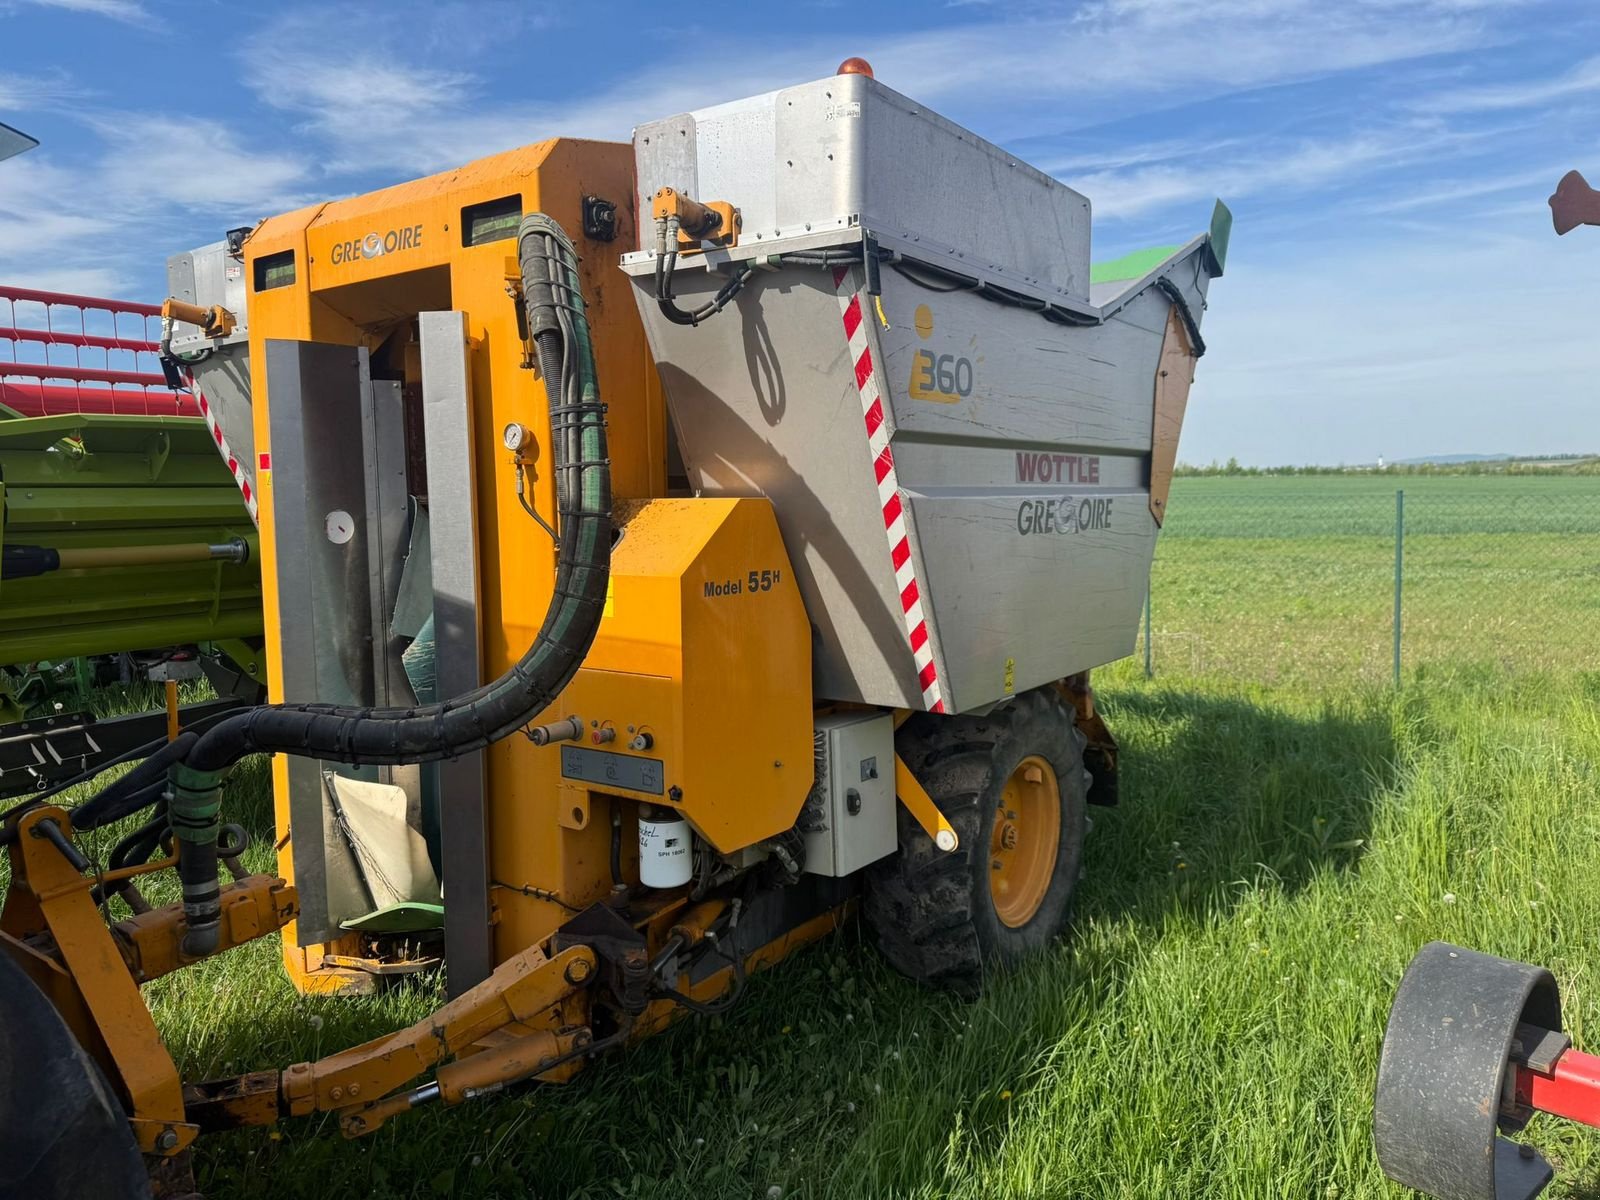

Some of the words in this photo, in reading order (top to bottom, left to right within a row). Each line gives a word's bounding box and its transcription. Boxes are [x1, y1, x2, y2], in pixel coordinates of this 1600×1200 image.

[331, 224, 422, 265] GREGOIRE
[1016, 452, 1099, 483] WOTTLE
[1017, 497, 1113, 536] GREGOIRE
[704, 579, 742, 597] Model
